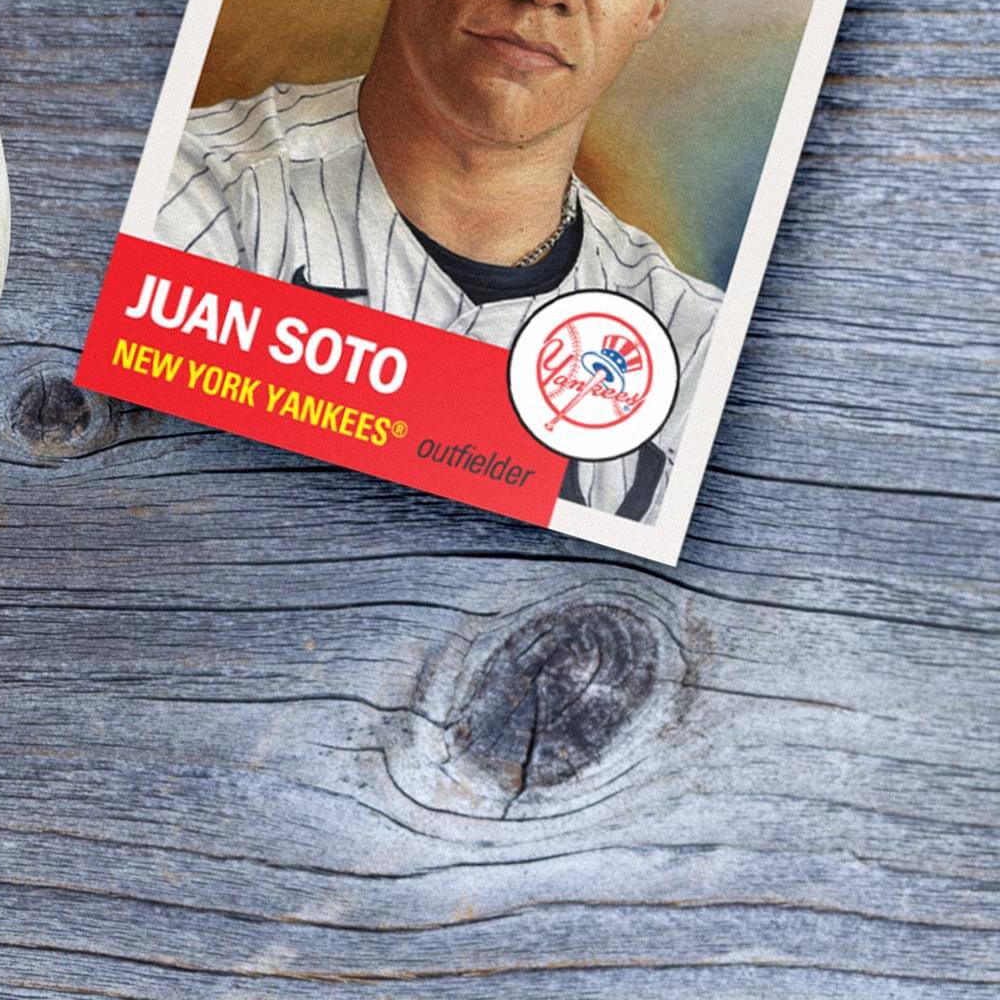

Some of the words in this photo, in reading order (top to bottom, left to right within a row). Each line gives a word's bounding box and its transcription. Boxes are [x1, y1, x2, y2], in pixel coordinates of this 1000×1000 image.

[125, 274, 262, 352] JUAN
[268, 316, 408, 395] SOTO
[111, 339, 184, 382] NEW
[188, 359, 261, 407] YORK
[416, 438, 536, 487] outfielder
